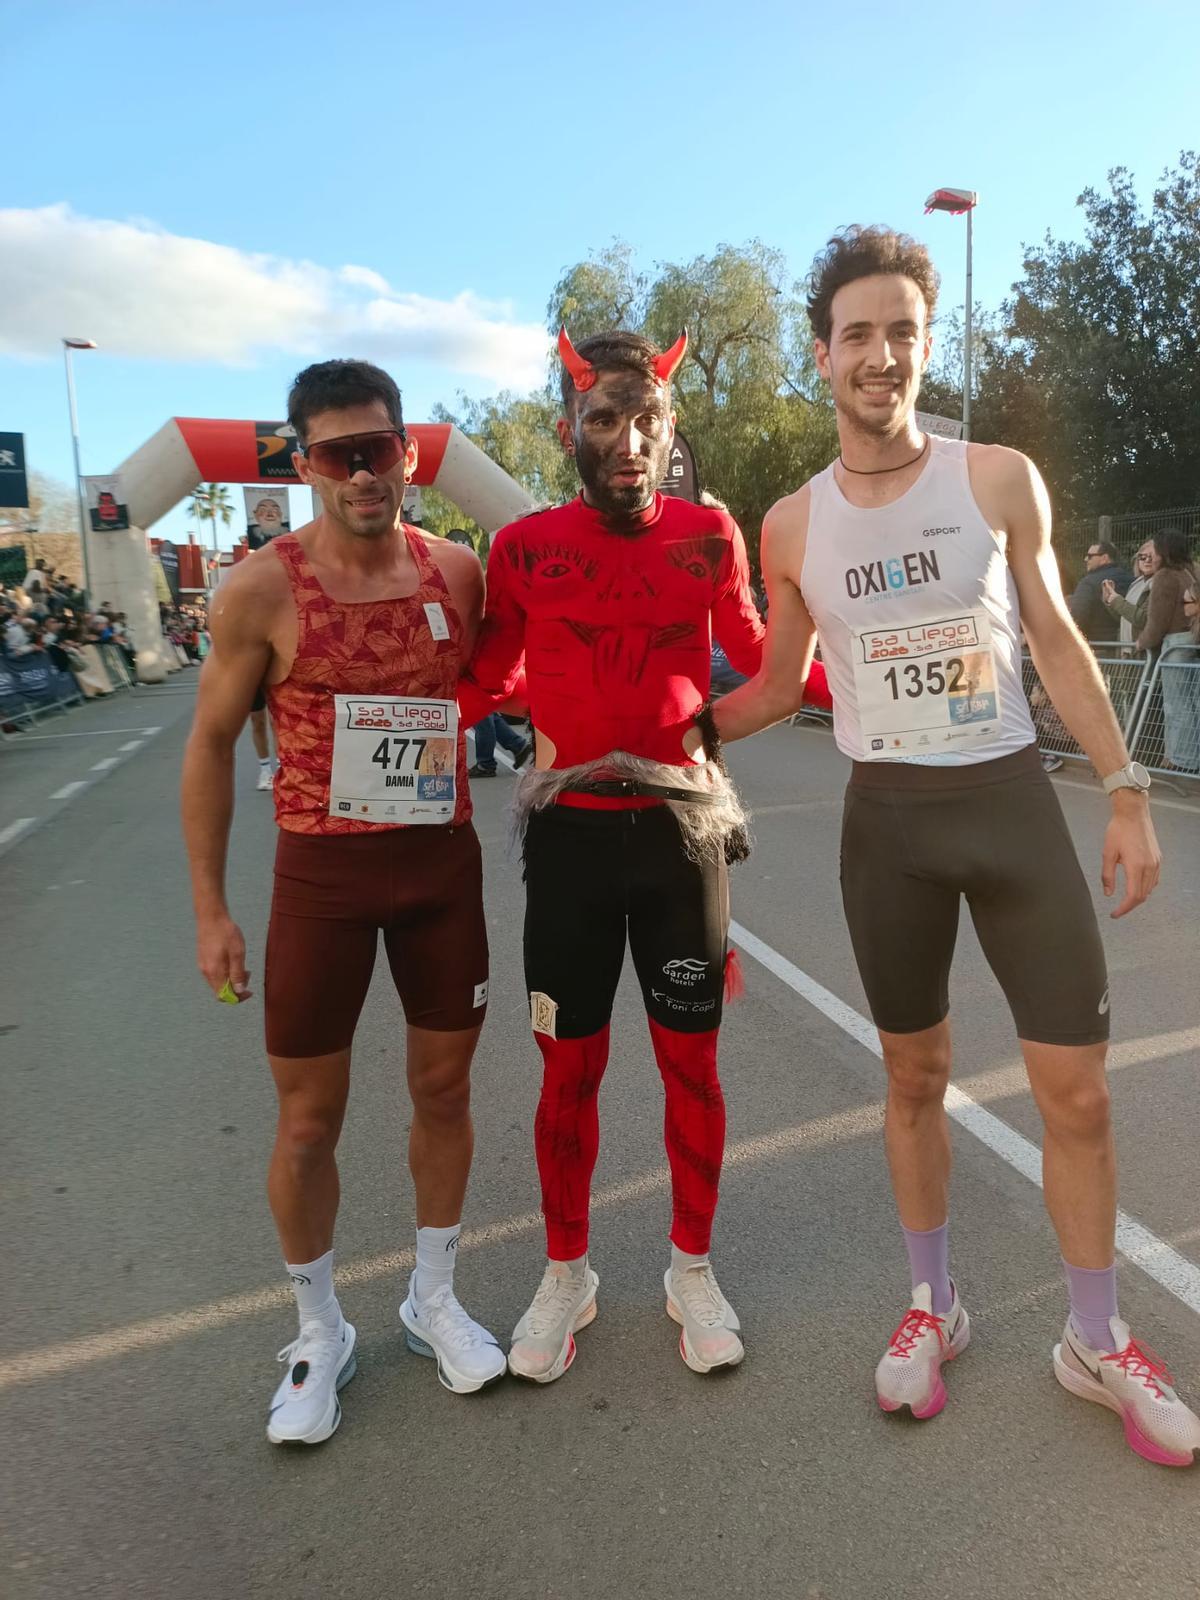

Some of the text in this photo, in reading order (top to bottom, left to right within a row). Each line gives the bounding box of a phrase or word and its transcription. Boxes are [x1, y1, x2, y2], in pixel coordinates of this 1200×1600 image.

[922, 526, 962, 538] GSPORT
[844, 549, 941, 600] OXIGEN
[907, 623, 970, 643] Llego
[870, 646, 909, 660] 2026
[938, 636, 976, 649] Pobla
[883, 658, 970, 700] 1352
[392, 705, 442, 721] Llego
[354, 718, 393, 728] 2026
[416, 720, 445, 729] Pobla
[371, 737, 427, 770] 477
[385, 773, 414, 787] DAMIÀ
[662, 966, 706, 980] Garden
[670, 977, 694, 986] hotels
[665, 999, 688, 1012] Toni
